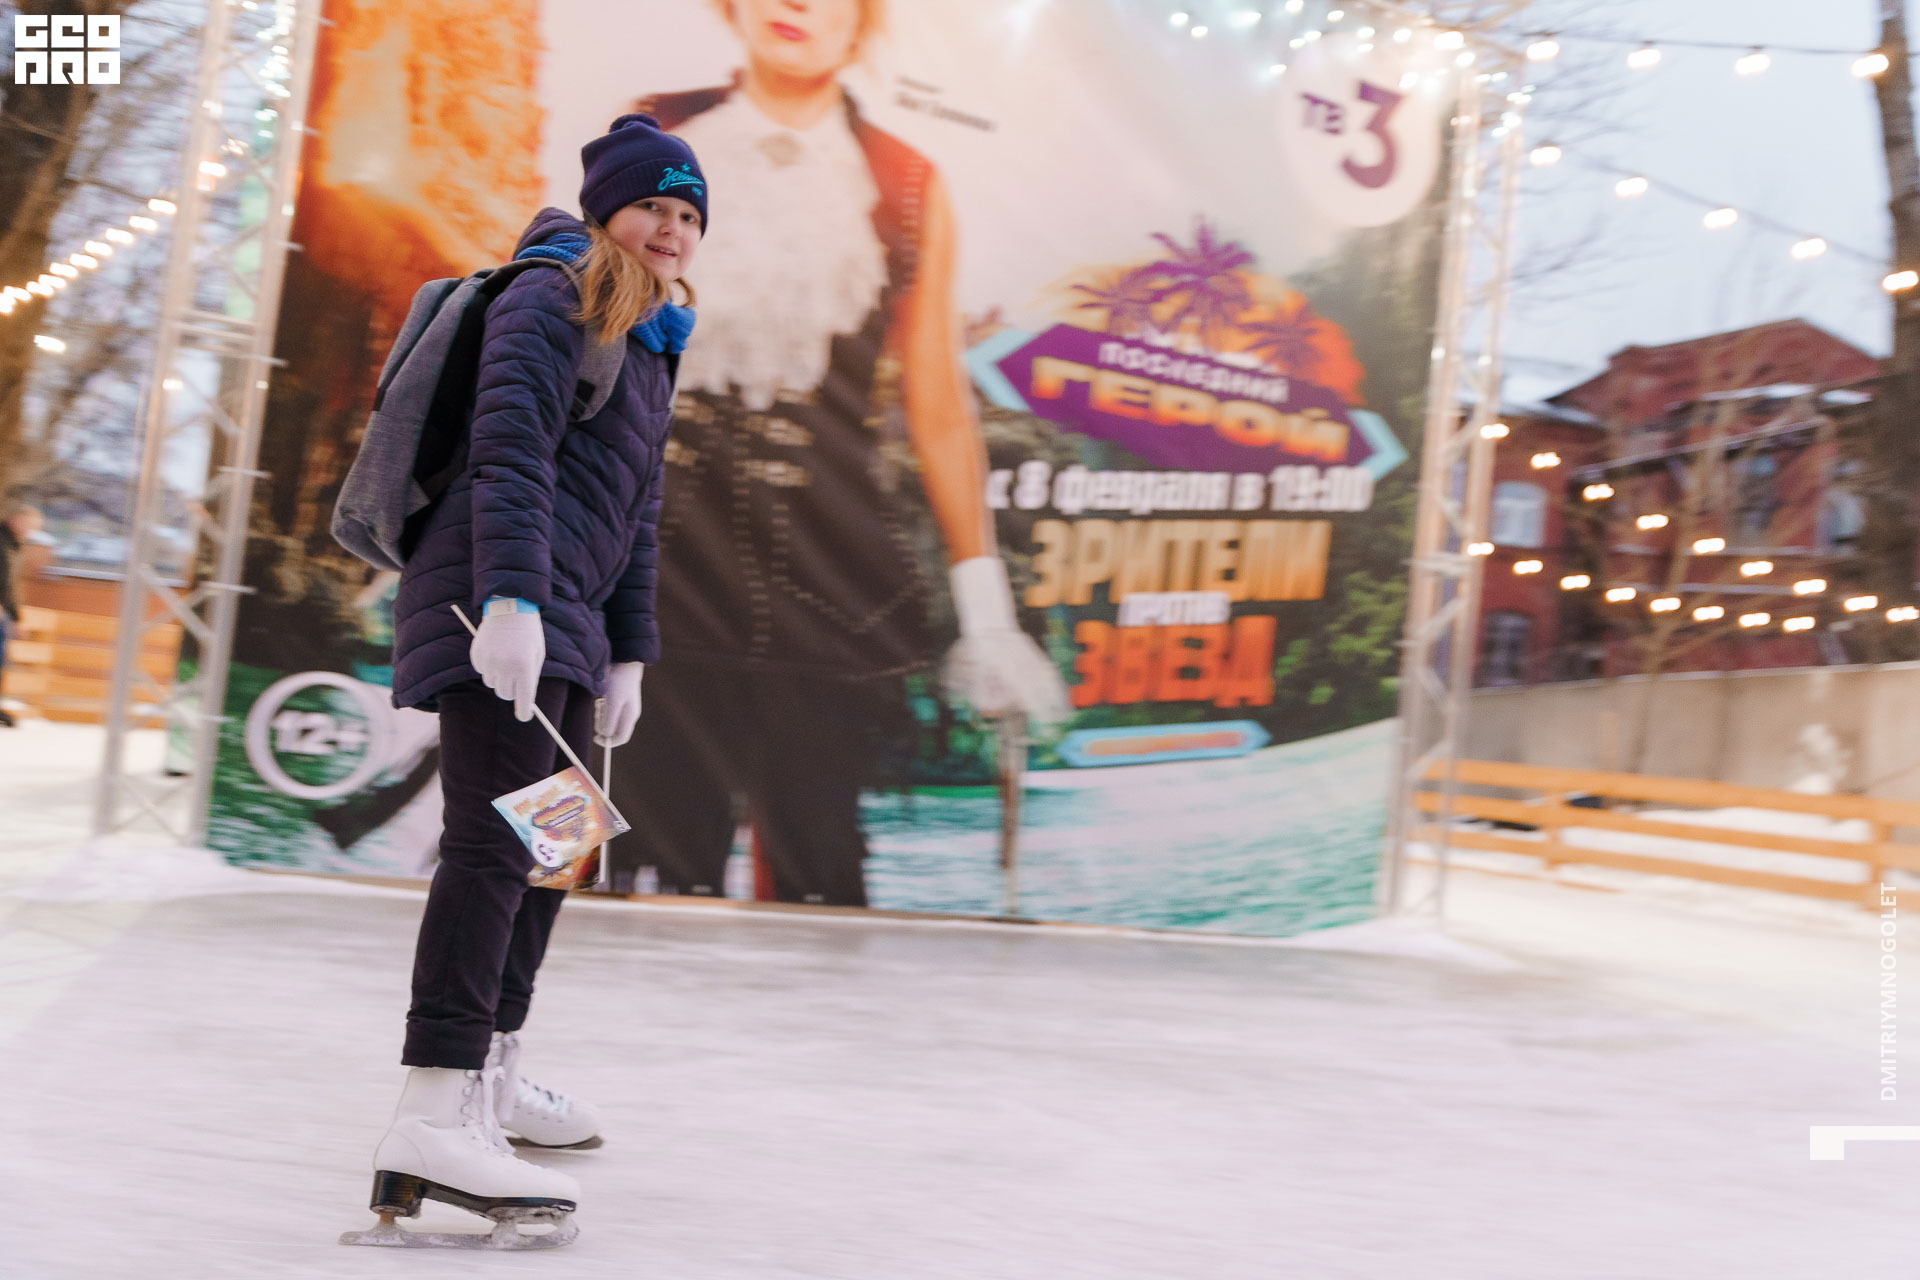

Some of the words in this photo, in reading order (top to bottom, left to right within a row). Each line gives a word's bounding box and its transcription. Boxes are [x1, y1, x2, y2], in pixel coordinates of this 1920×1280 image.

[1031, 356, 1348, 461] ГЕРОЙ
[1014, 460, 1052, 510] 8
[1053, 464, 1231, 515] февраля
[1234, 472, 1266, 511] в
[1270, 465, 1375, 512] 19:00
[1024, 519, 1332, 607] ЗРИТЕЛИ
[270, 709, 368, 755] 12+
